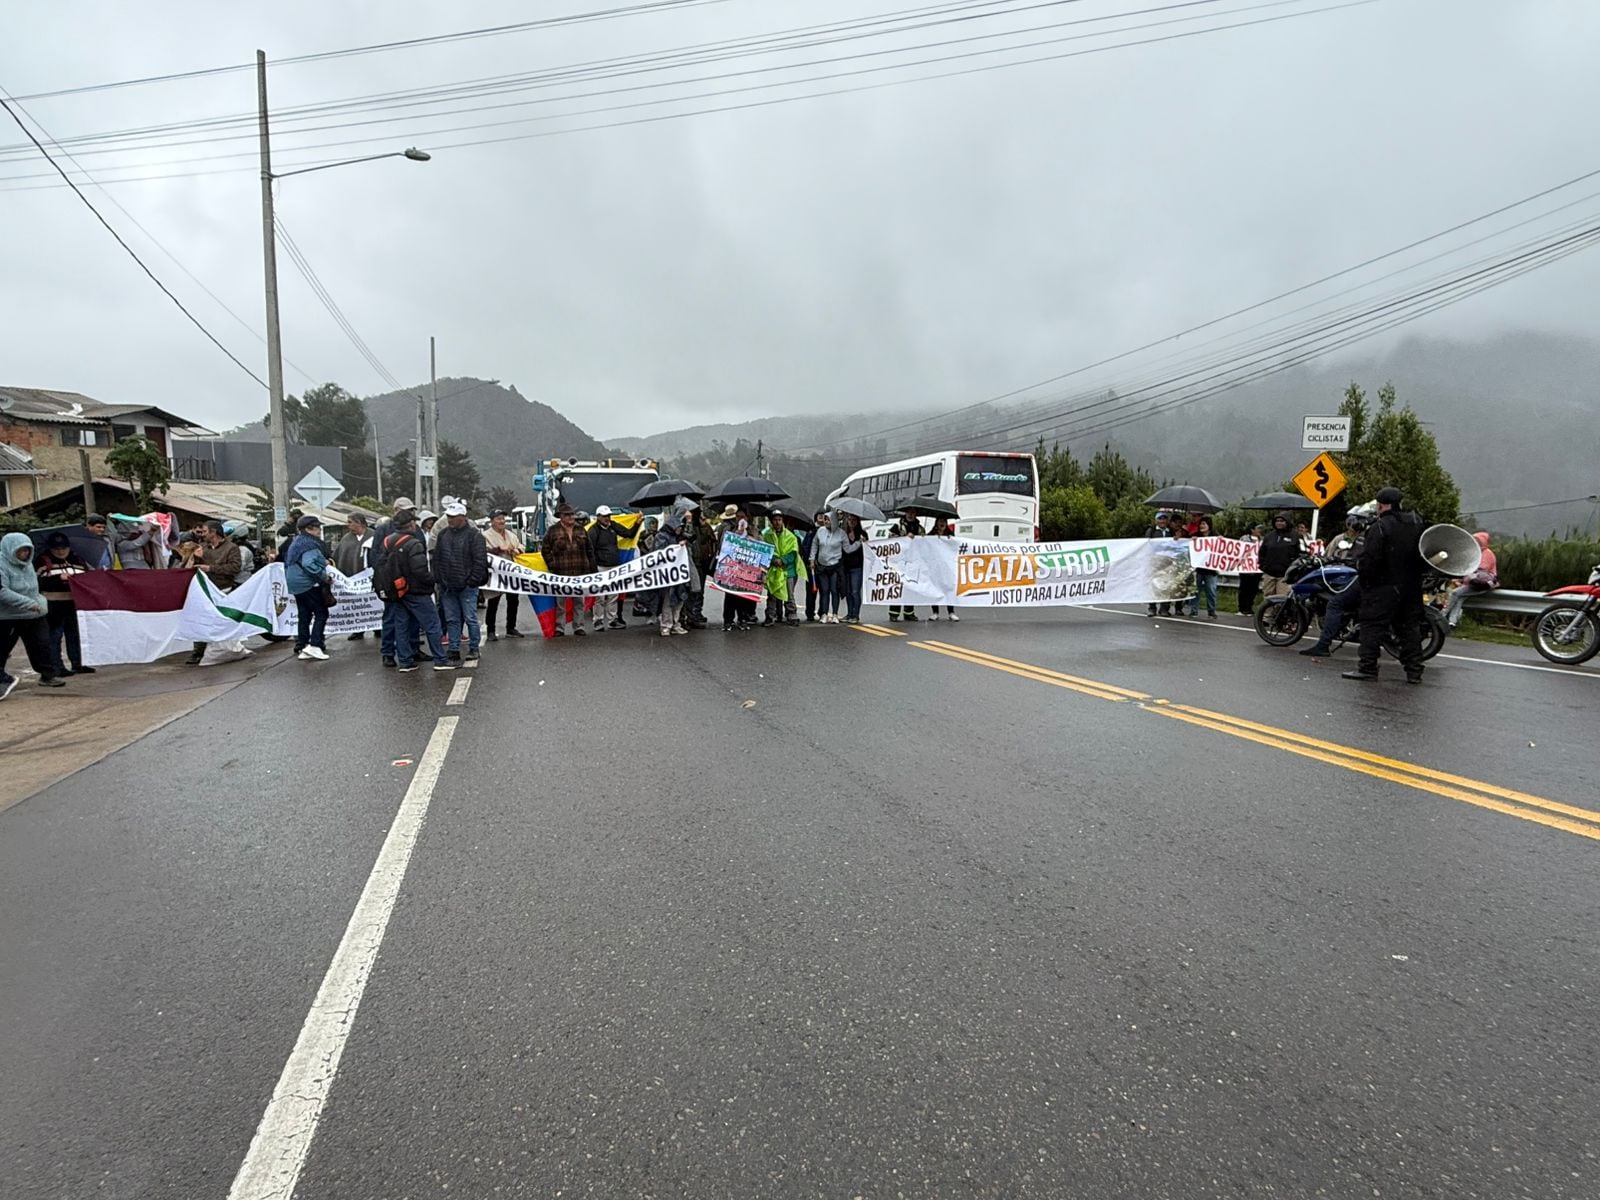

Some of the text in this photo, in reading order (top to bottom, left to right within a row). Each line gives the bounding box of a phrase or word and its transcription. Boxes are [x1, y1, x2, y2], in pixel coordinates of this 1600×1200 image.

[972, 542, 1017, 555] unidos
[1020, 543, 1041, 556] por
[1044, 543, 1062, 553] un
[1193, 537, 1241, 557] UNIDOS
[538, 573, 603, 584] ABUSOS
[608, 563, 636, 580] DEL
[640, 548, 676, 571] IGAC
[497, 573, 584, 596] NUESTROS
[588, 564, 690, 595] CAMPESINOS
[875, 571, 901, 586] PERO
[871, 588, 885, 602] NO
[991, 580, 1105, 605] JUSTO PARA LA CALERA
